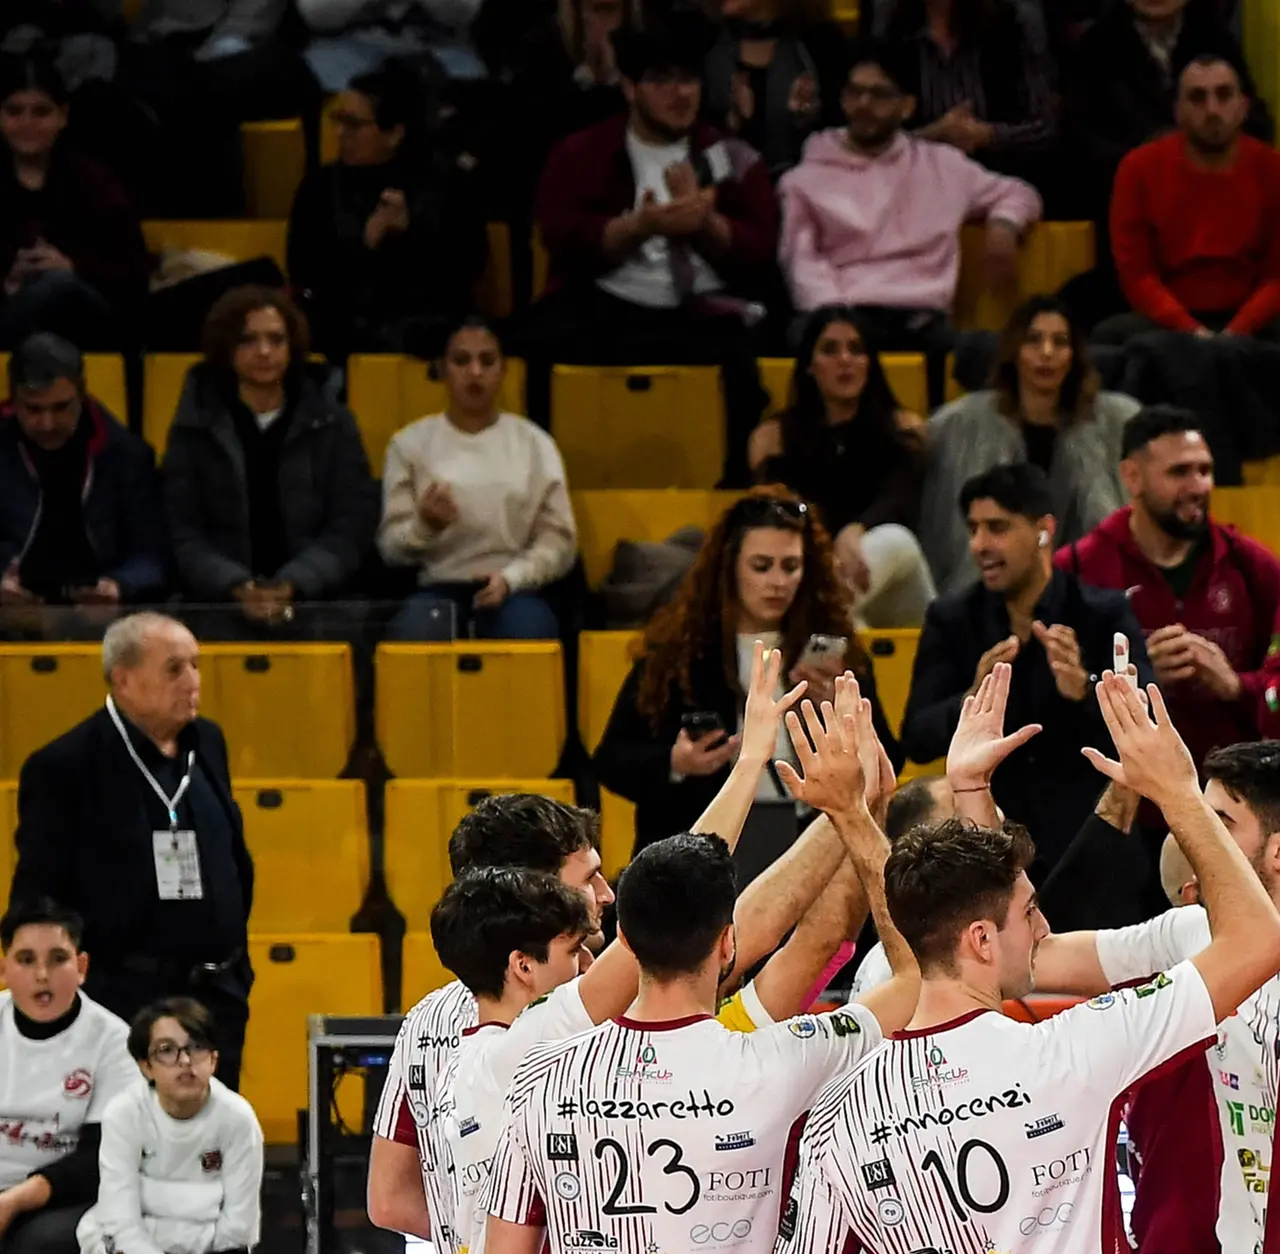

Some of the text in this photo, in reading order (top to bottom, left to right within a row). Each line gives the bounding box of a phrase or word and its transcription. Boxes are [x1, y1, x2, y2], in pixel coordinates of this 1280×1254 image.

[418, 1031, 459, 1049] #mo
[557, 1085, 734, 1120] #lazzaretto
[870, 1083, 1032, 1144] #innocenzi
[595, 1137, 700, 1215] 23
[708, 1168, 771, 1191] FOTI
[921, 1139, 1009, 1222] 10
[1031, 1148, 1090, 1186] FOTI
[690, 1218, 751, 1244] eco
